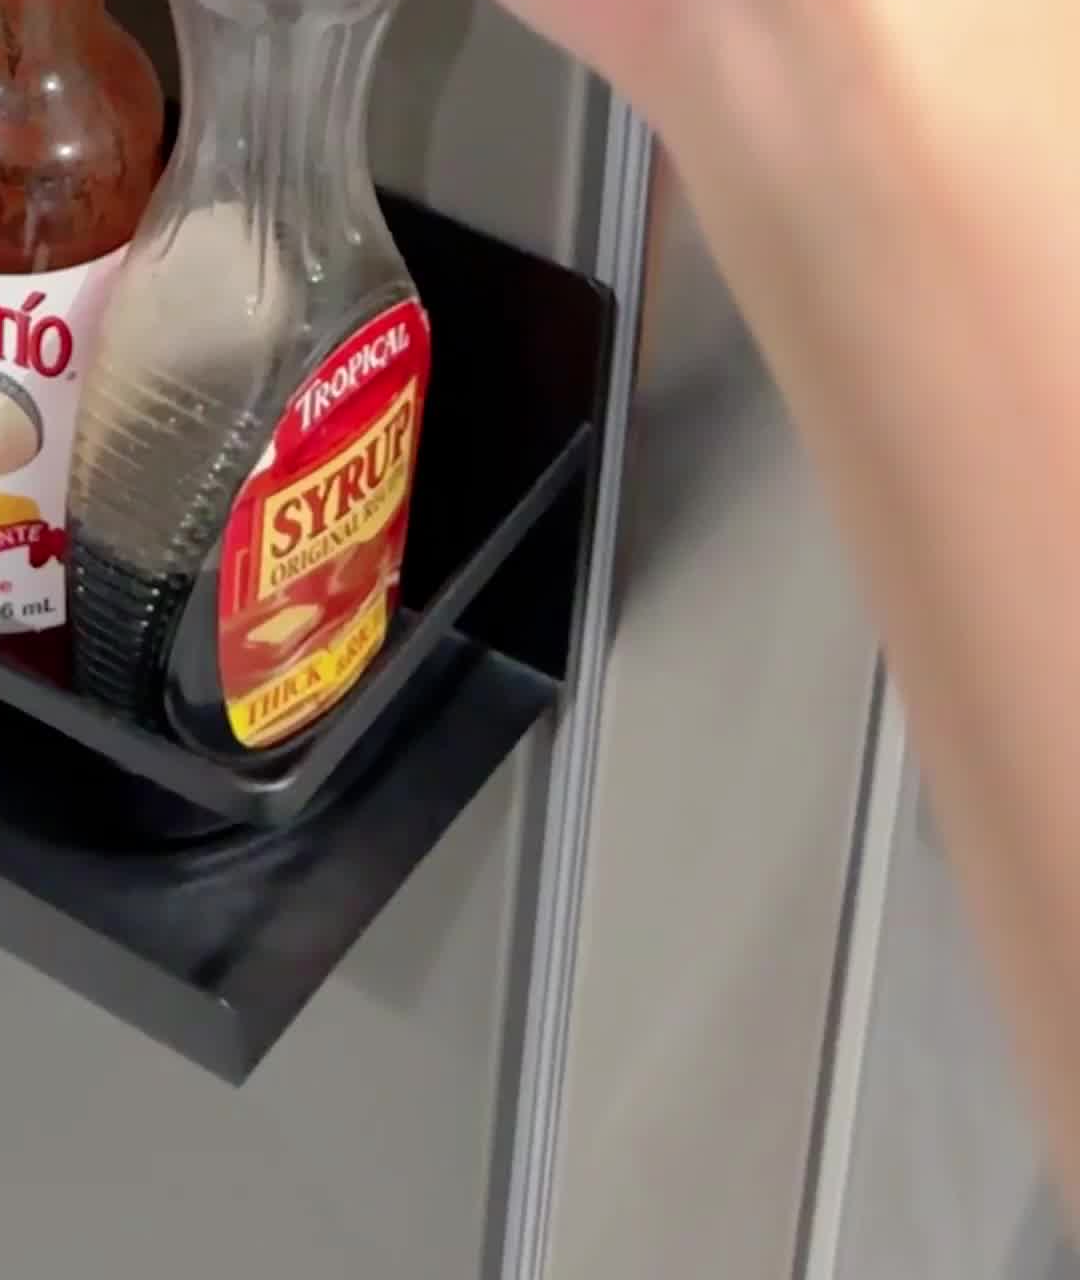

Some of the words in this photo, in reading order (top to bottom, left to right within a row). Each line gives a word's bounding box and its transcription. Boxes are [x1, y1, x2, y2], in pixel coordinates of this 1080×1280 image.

[295, 321, 411, 432] TROPICAL
[269, 397, 414, 559] SYRUP
[269, 513, 360, 585] ORIGINAL
[22, 597, 56, 617] mL
